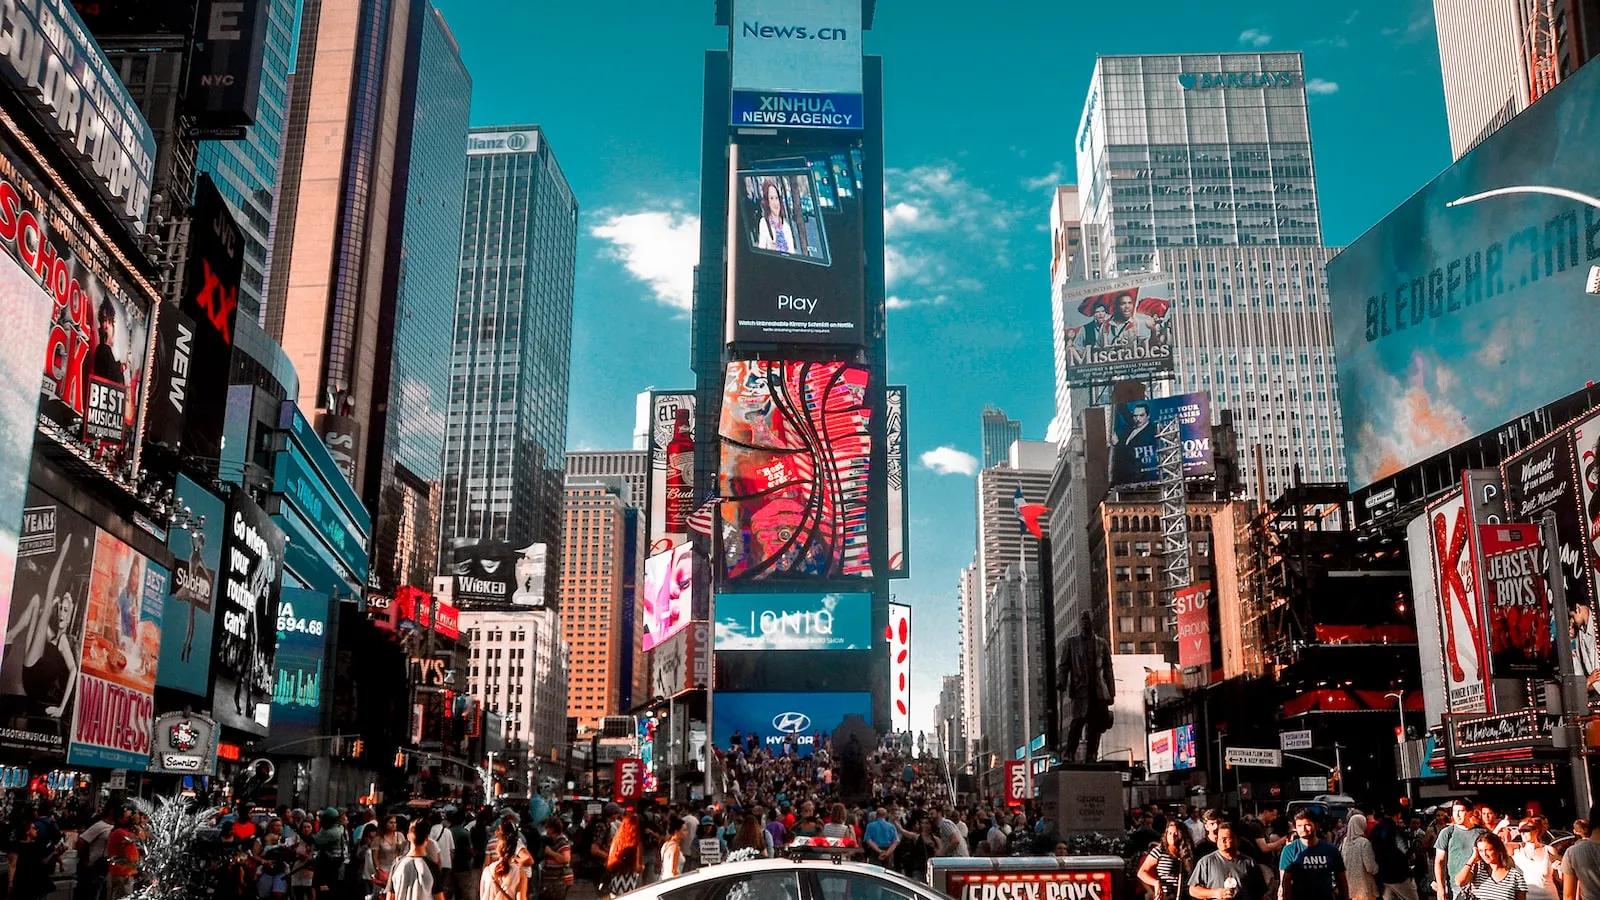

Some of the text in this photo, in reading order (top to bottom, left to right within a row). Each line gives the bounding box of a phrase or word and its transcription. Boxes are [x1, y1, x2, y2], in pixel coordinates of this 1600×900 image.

[743, 21, 847, 41] News.cn
[201, 74, 235, 86] NYC
[1201, 72, 1291, 89] BARCLAYS
[760, 96, 836, 113] XINHUA
[742, 111, 853, 126] NEWS AGENCY
[212, 212, 236, 258] JVC
[0, 179, 91, 341] SCHOOL
[778, 294, 818, 315] Play
[1069, 340, 1171, 367] Misérables
[168, 323, 193, 414] NEW
[89, 382, 125, 413] BEST
[24, 512, 54, 532] YEARS
[1487, 549, 1539, 581] JERSEY
[146, 568, 166, 594] BEST
[1496, 576, 1536, 607] BOYS
[277, 616, 324, 637] 694.68
[751, 609, 833, 635] IONIQ
[165, 756, 198, 768] Sanrio
[621, 762, 635, 797] tkts
[1012, 763, 1026, 799] tkts
[1303, 855, 1327, 865] ANU
